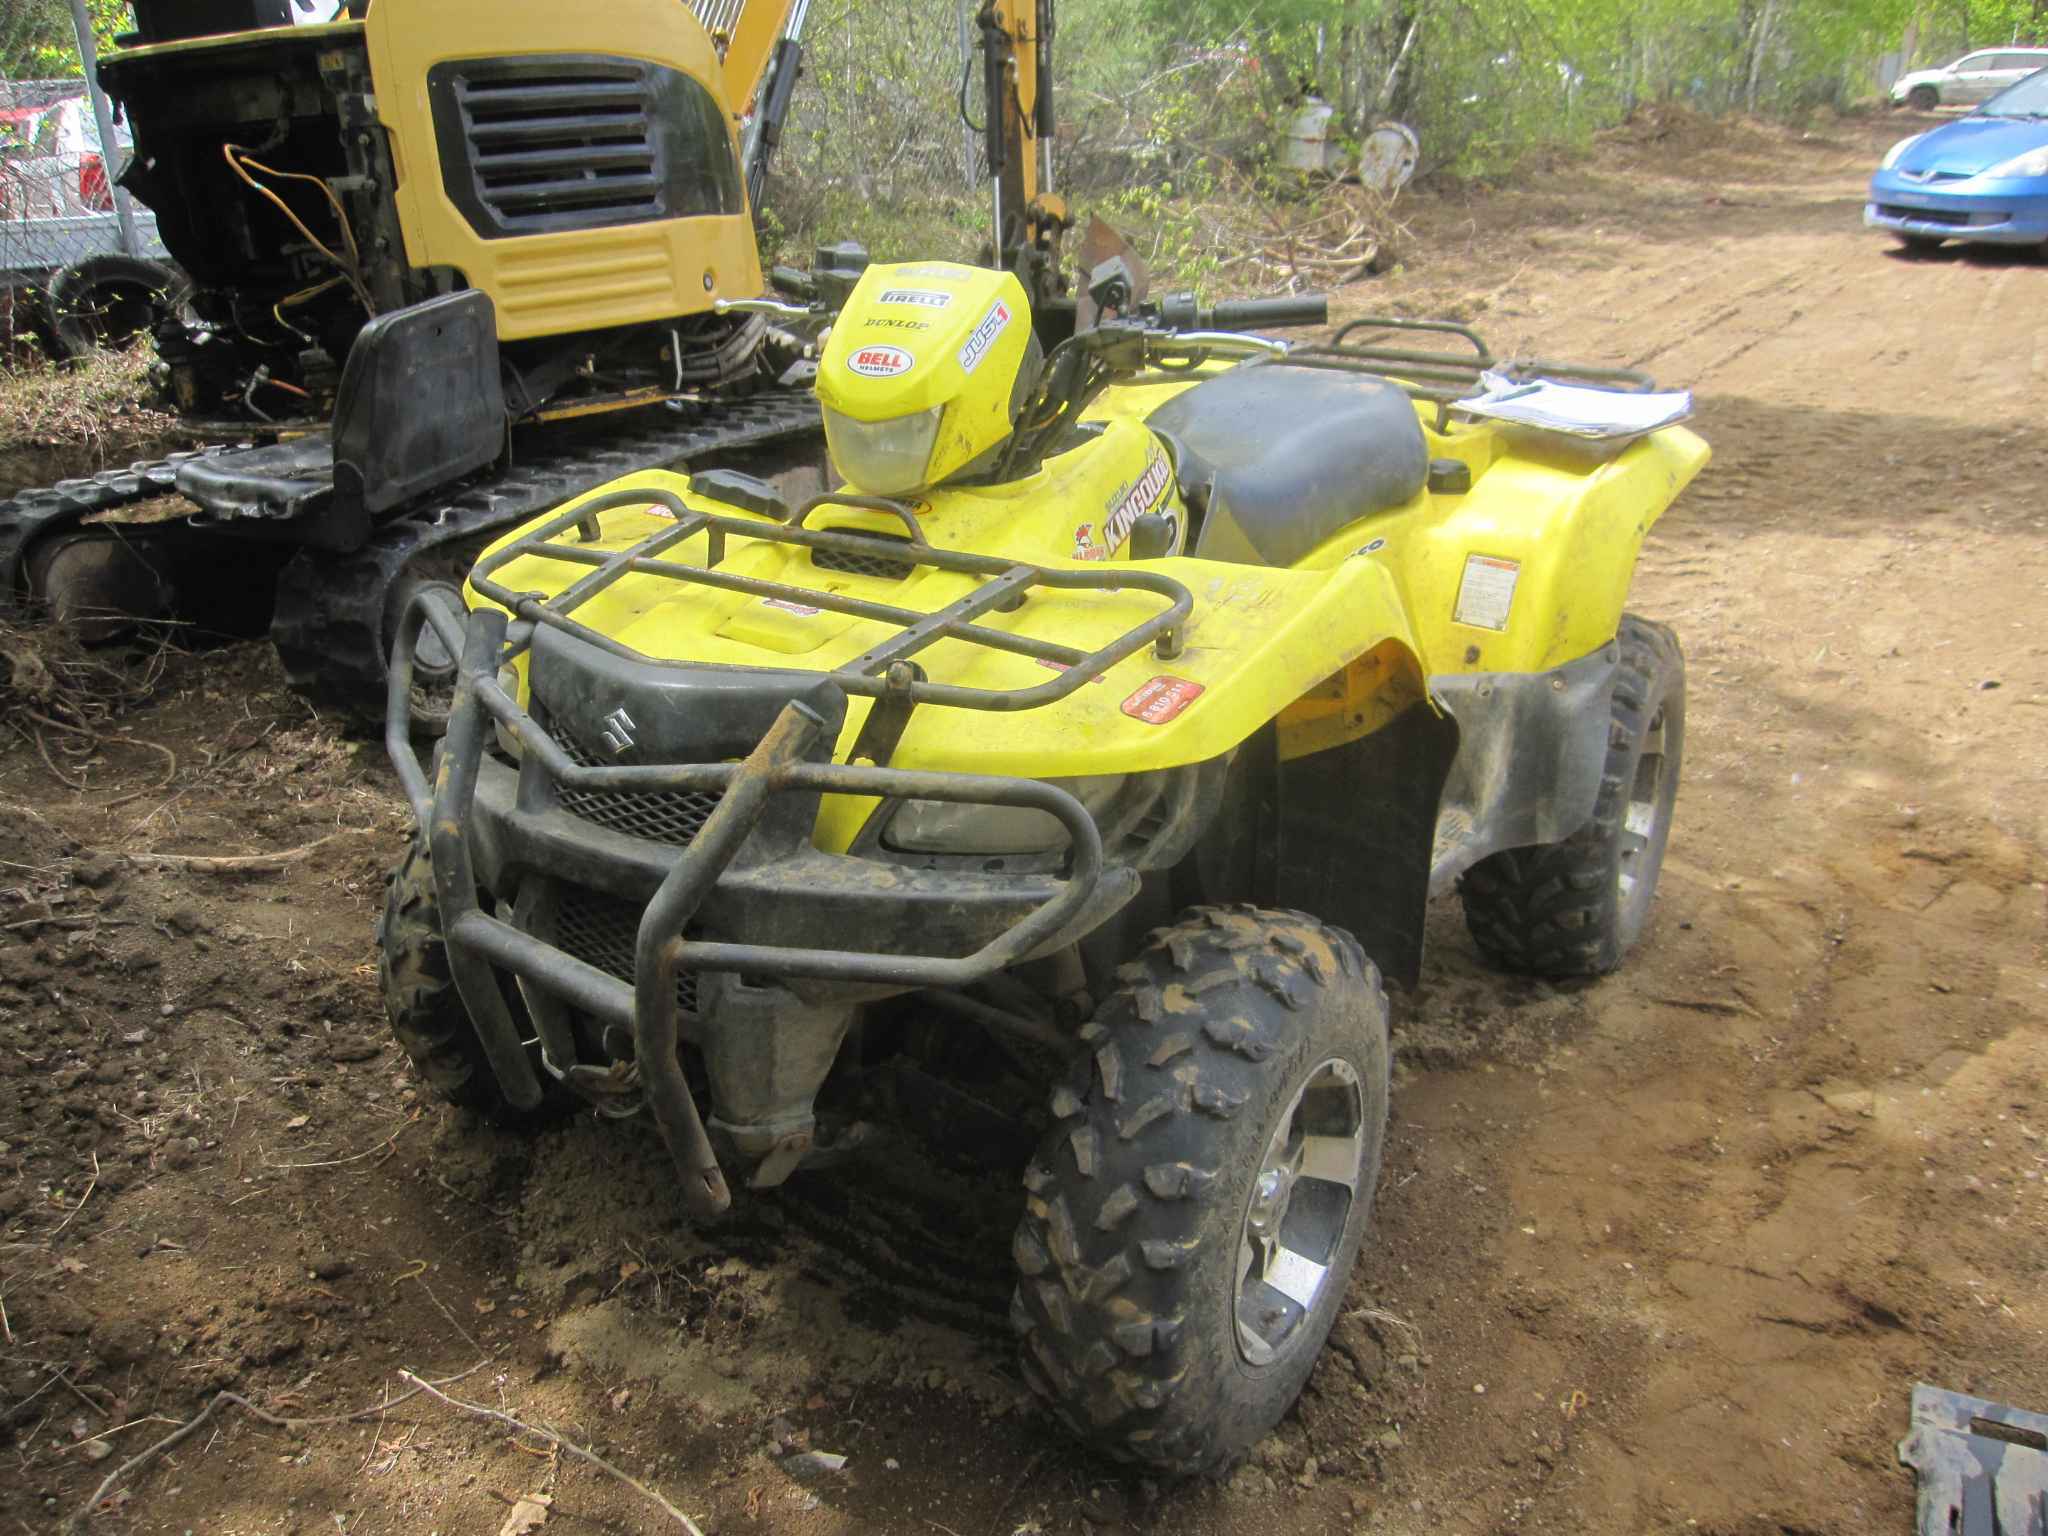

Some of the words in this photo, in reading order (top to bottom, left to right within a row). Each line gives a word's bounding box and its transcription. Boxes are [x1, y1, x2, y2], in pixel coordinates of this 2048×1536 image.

[880, 290, 950, 306] PIRELLI
[864, 318, 930, 330] DUNLOP
[857, 351, 902, 368] BELL
[859, 365, 894, 373] HELMETS
